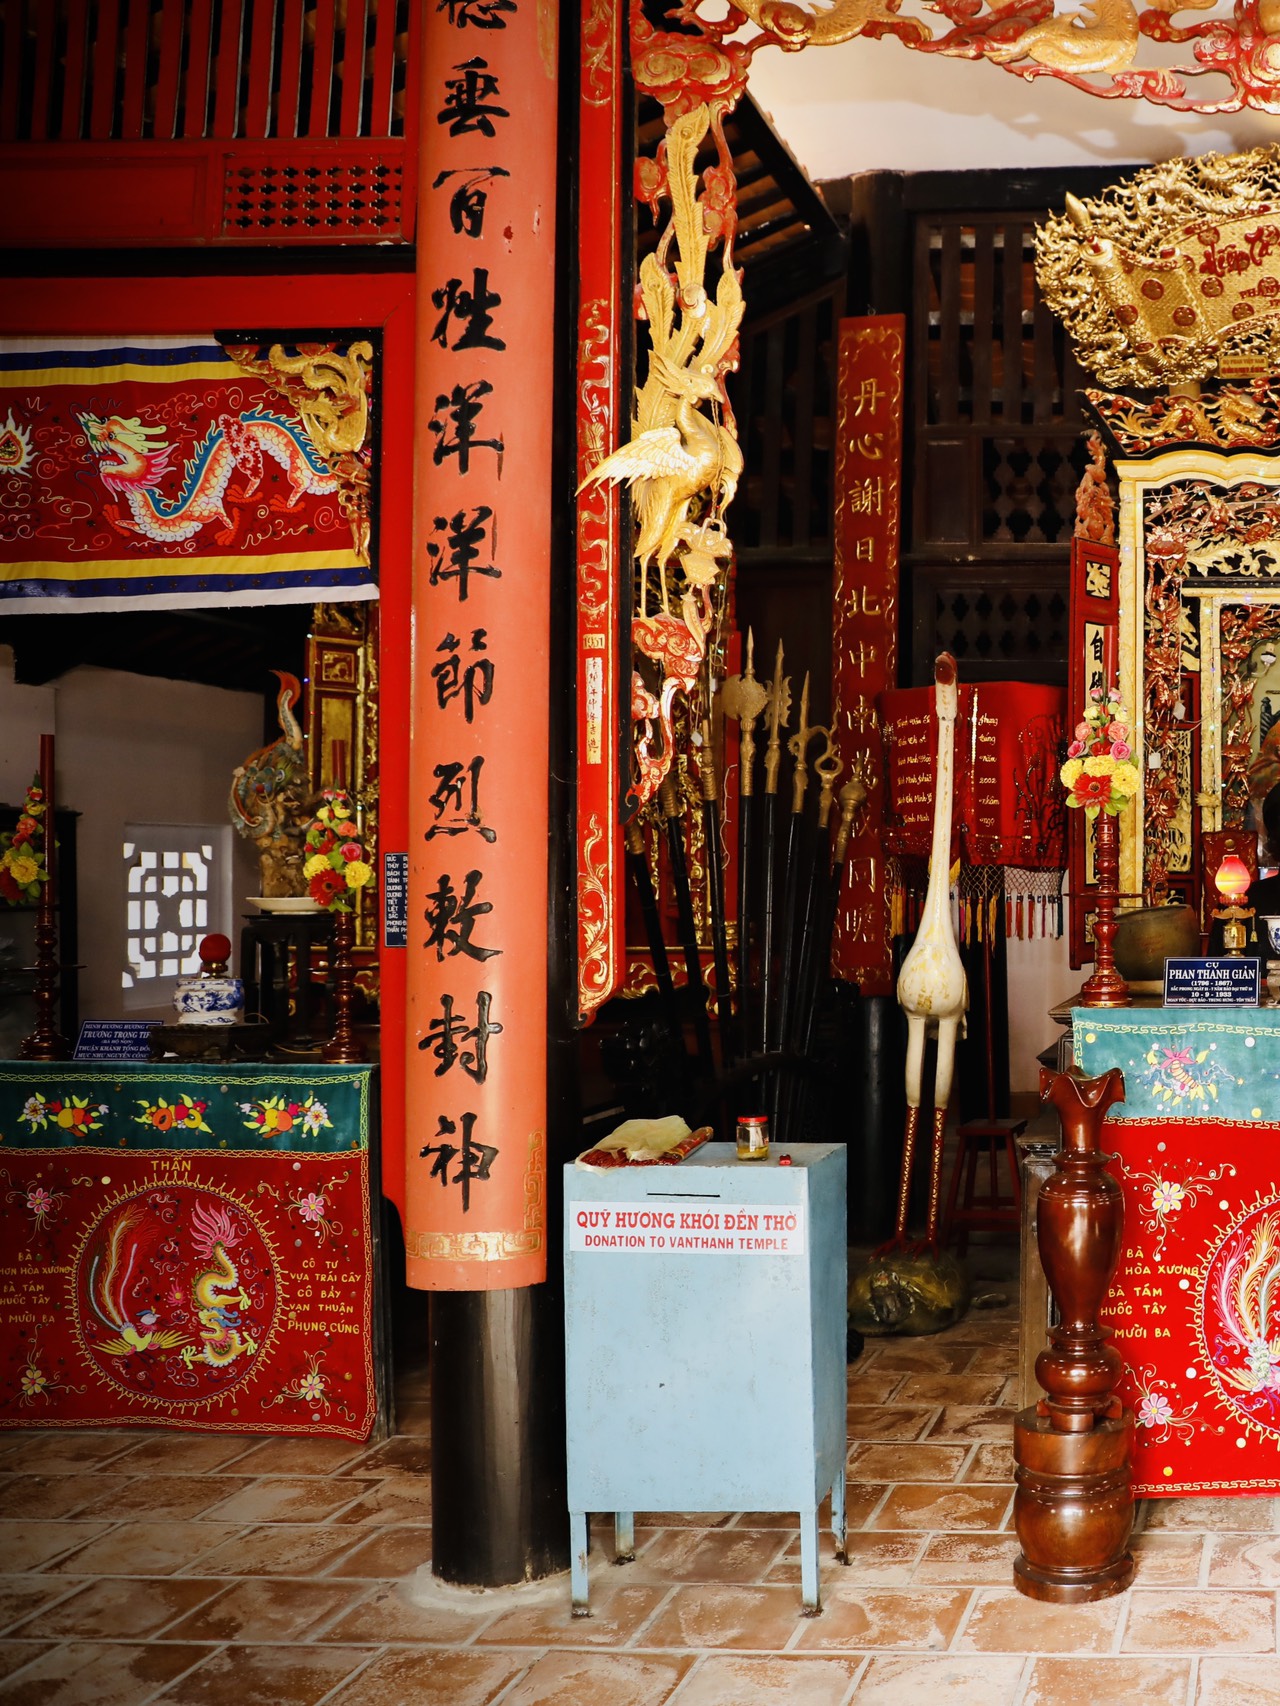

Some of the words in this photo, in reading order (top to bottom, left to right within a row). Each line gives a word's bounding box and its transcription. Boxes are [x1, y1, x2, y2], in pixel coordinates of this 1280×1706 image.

[1239, 285, 1278, 299] PHAN
[1169, 969, 1195, 980] PHAN
[1196, 969, 1230, 980] THANH
[1231, 965, 1256, 980] GIẢN
[151, 1157, 191, 1171] THẦN
[576, 1209, 611, 1229] QUỸ
[615, 1210, 676, 1229] HƯƠNG
[679, 1209, 720, 1230] KHÓI
[724, 1208, 759, 1231] ĐỀN
[763, 1210, 798, 1232] THỜ
[584, 1234, 646, 1248] DONATION
[649, 1236, 666, 1248] TO
[669, 1236, 734, 1249] VANTHANH
[738, 1237, 788, 1250] TEMPLE
[18, 1249, 32, 1261] BÀ
[1127, 1246, 1144, 1258] BÀ
[20, 1263, 39, 1275] HÒA
[42, 1266, 70, 1274] XƯƠNG
[302, 1257, 316, 1269] CÔ
[325, 1260, 339, 1269] TƯ
[1125, 1263, 1151, 1275] HÒA
[1158, 1265, 1199, 1275] XƯƠNG
[290, 1272, 310, 1283] VỰA
[315, 1271, 337, 1282] TRÁI
[341, 1271, 361, 1283] CÂY
[3, 1281, 15, 1293] BÀ
[22, 1280, 44, 1292] TÁM
[297, 1284, 313, 1298] CÔ
[320, 1285, 342, 1298] BẢY
[1108, 1285, 1125, 1298] BÀ
[1134, 1283, 1162, 1297] TÁM
[32, 1293, 50, 1304] TÂY
[289, 1303, 310, 1313] VẠN
[318, 1302, 354, 1315] THUẬN
[1143, 1302, 1167, 1314] TÂY
[9, 1310, 36, 1323] MƯỜI
[42, 1314, 55, 1323] BA
[287, 1320, 327, 1335] PHỤNG
[329, 1319, 360, 1335] CÚNG
[1115, 1324, 1147, 1339] MƯỜI
[1155, 1328, 1171, 1338] BA
